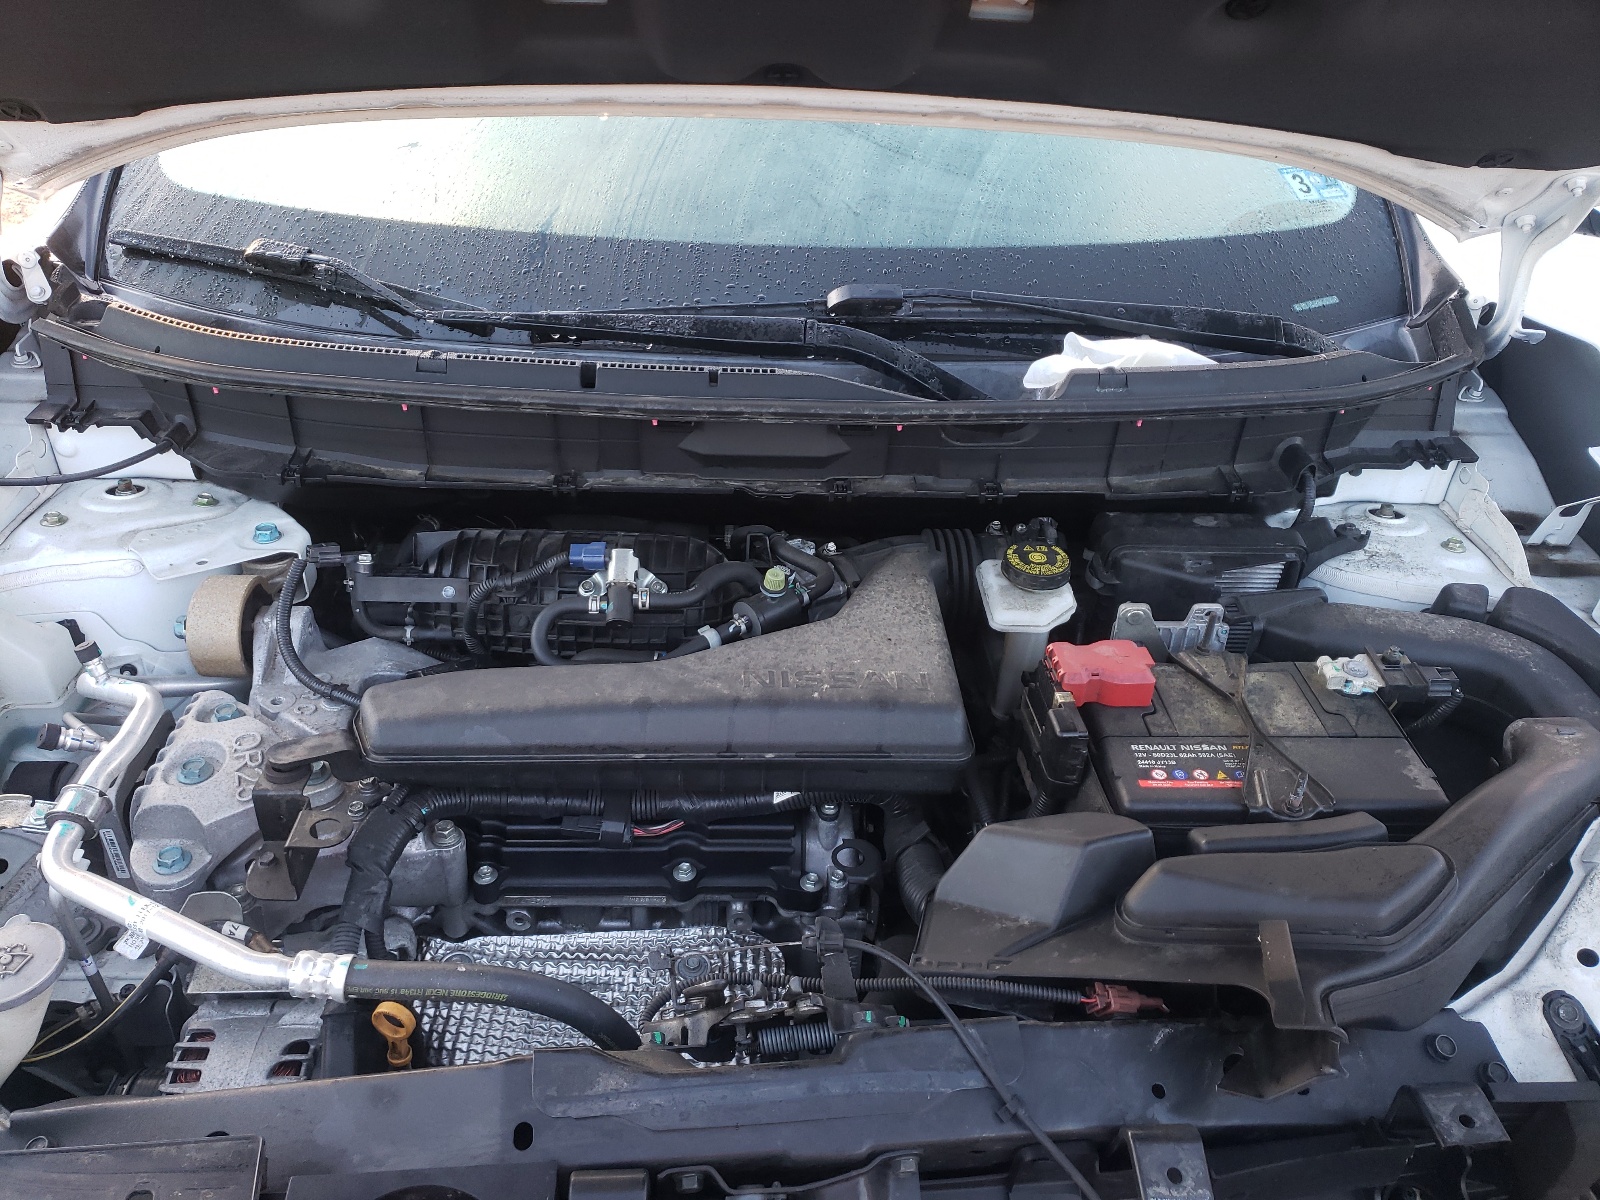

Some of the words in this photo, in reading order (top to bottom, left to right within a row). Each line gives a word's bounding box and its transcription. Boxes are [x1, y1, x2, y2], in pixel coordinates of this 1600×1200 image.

[1291, 173, 1312, 194] 3
[742, 669, 931, 690] NISSAN
[232, 732, 263, 802] QR25
